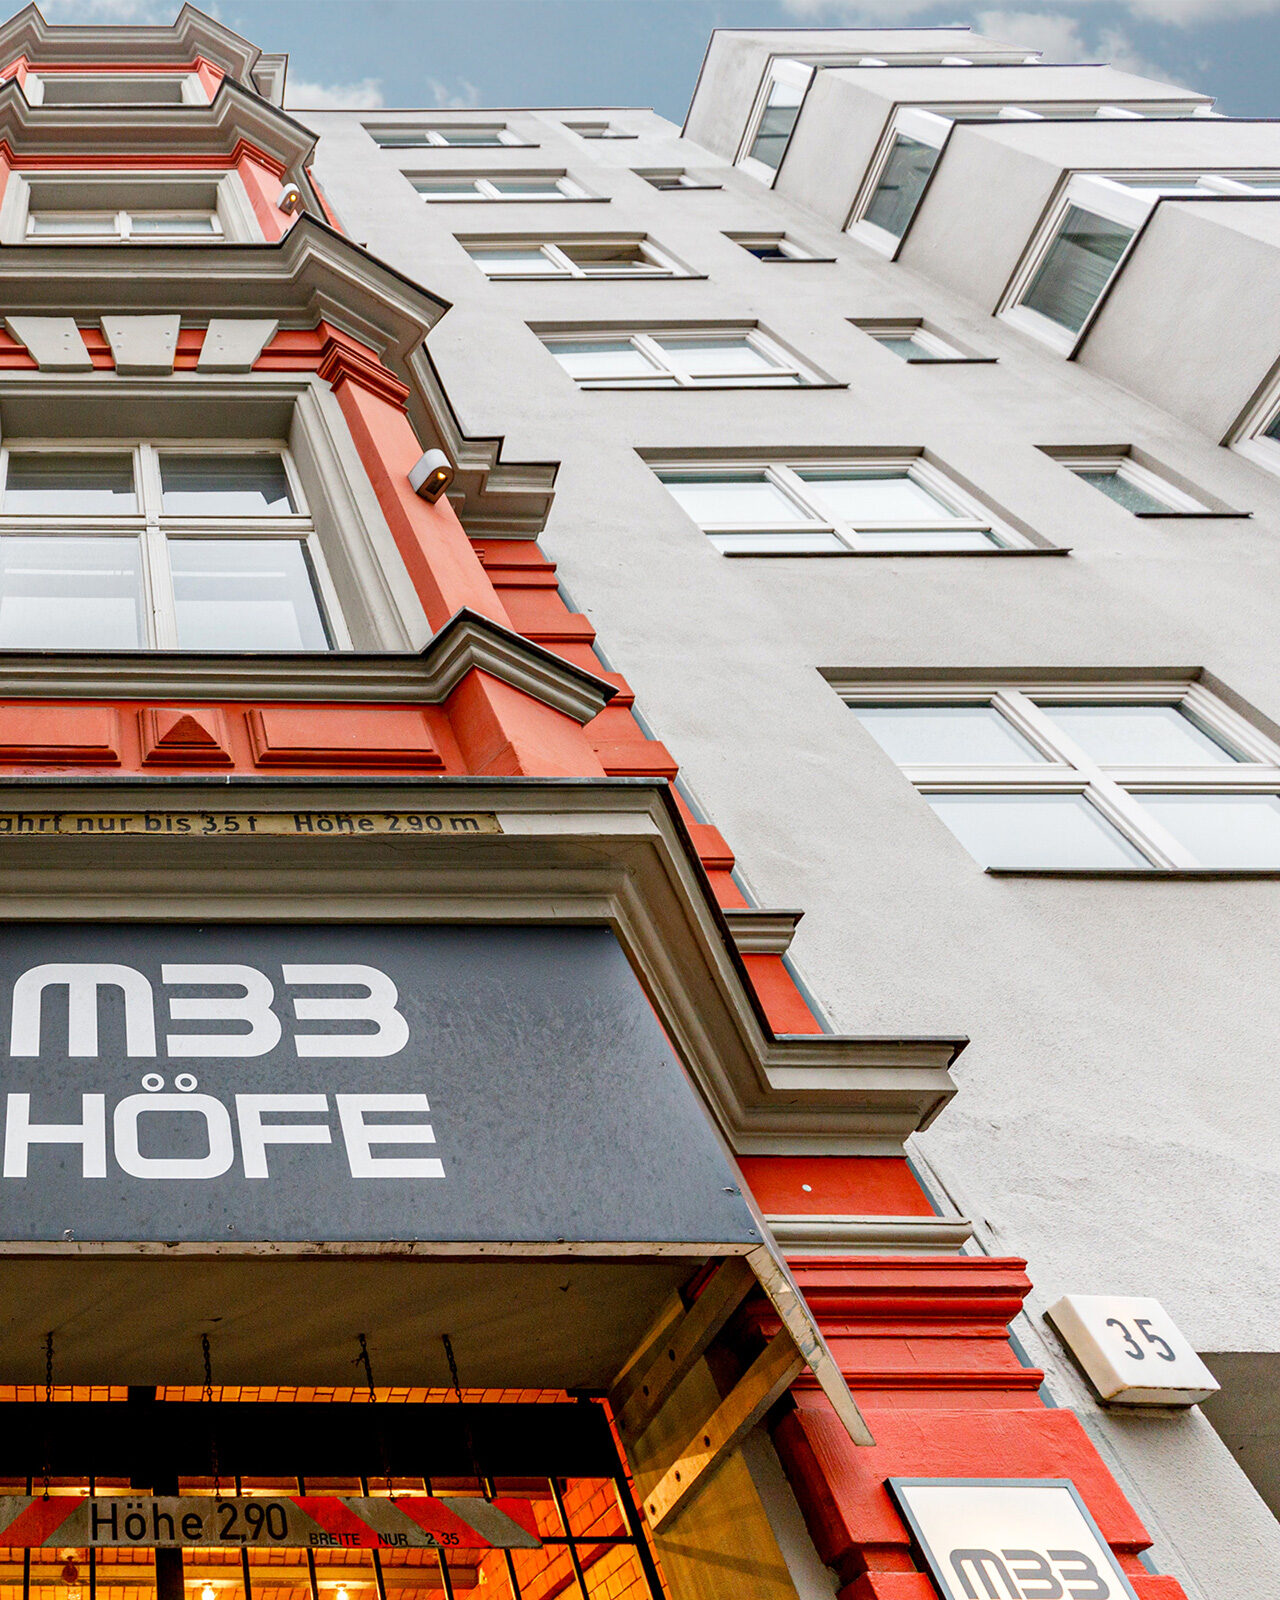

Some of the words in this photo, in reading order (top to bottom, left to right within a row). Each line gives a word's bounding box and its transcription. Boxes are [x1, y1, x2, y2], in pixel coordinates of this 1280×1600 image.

[77, 816, 132, 832] nur
[145, 814, 192, 832] bis
[248, 815, 257, 831] t
[293, 814, 375, 832] Höhe
[450, 817, 480, 831] m
[3, 1073, 446, 1178] HÖFE
[1106, 1318, 1176, 1362] 35
[91, 1502, 203, 1540] Höhe
[217, 1502, 288, 1543] 2,90
[309, 1532, 361, 1545] BREITE
[377, 1532, 408, 1546] NUR
